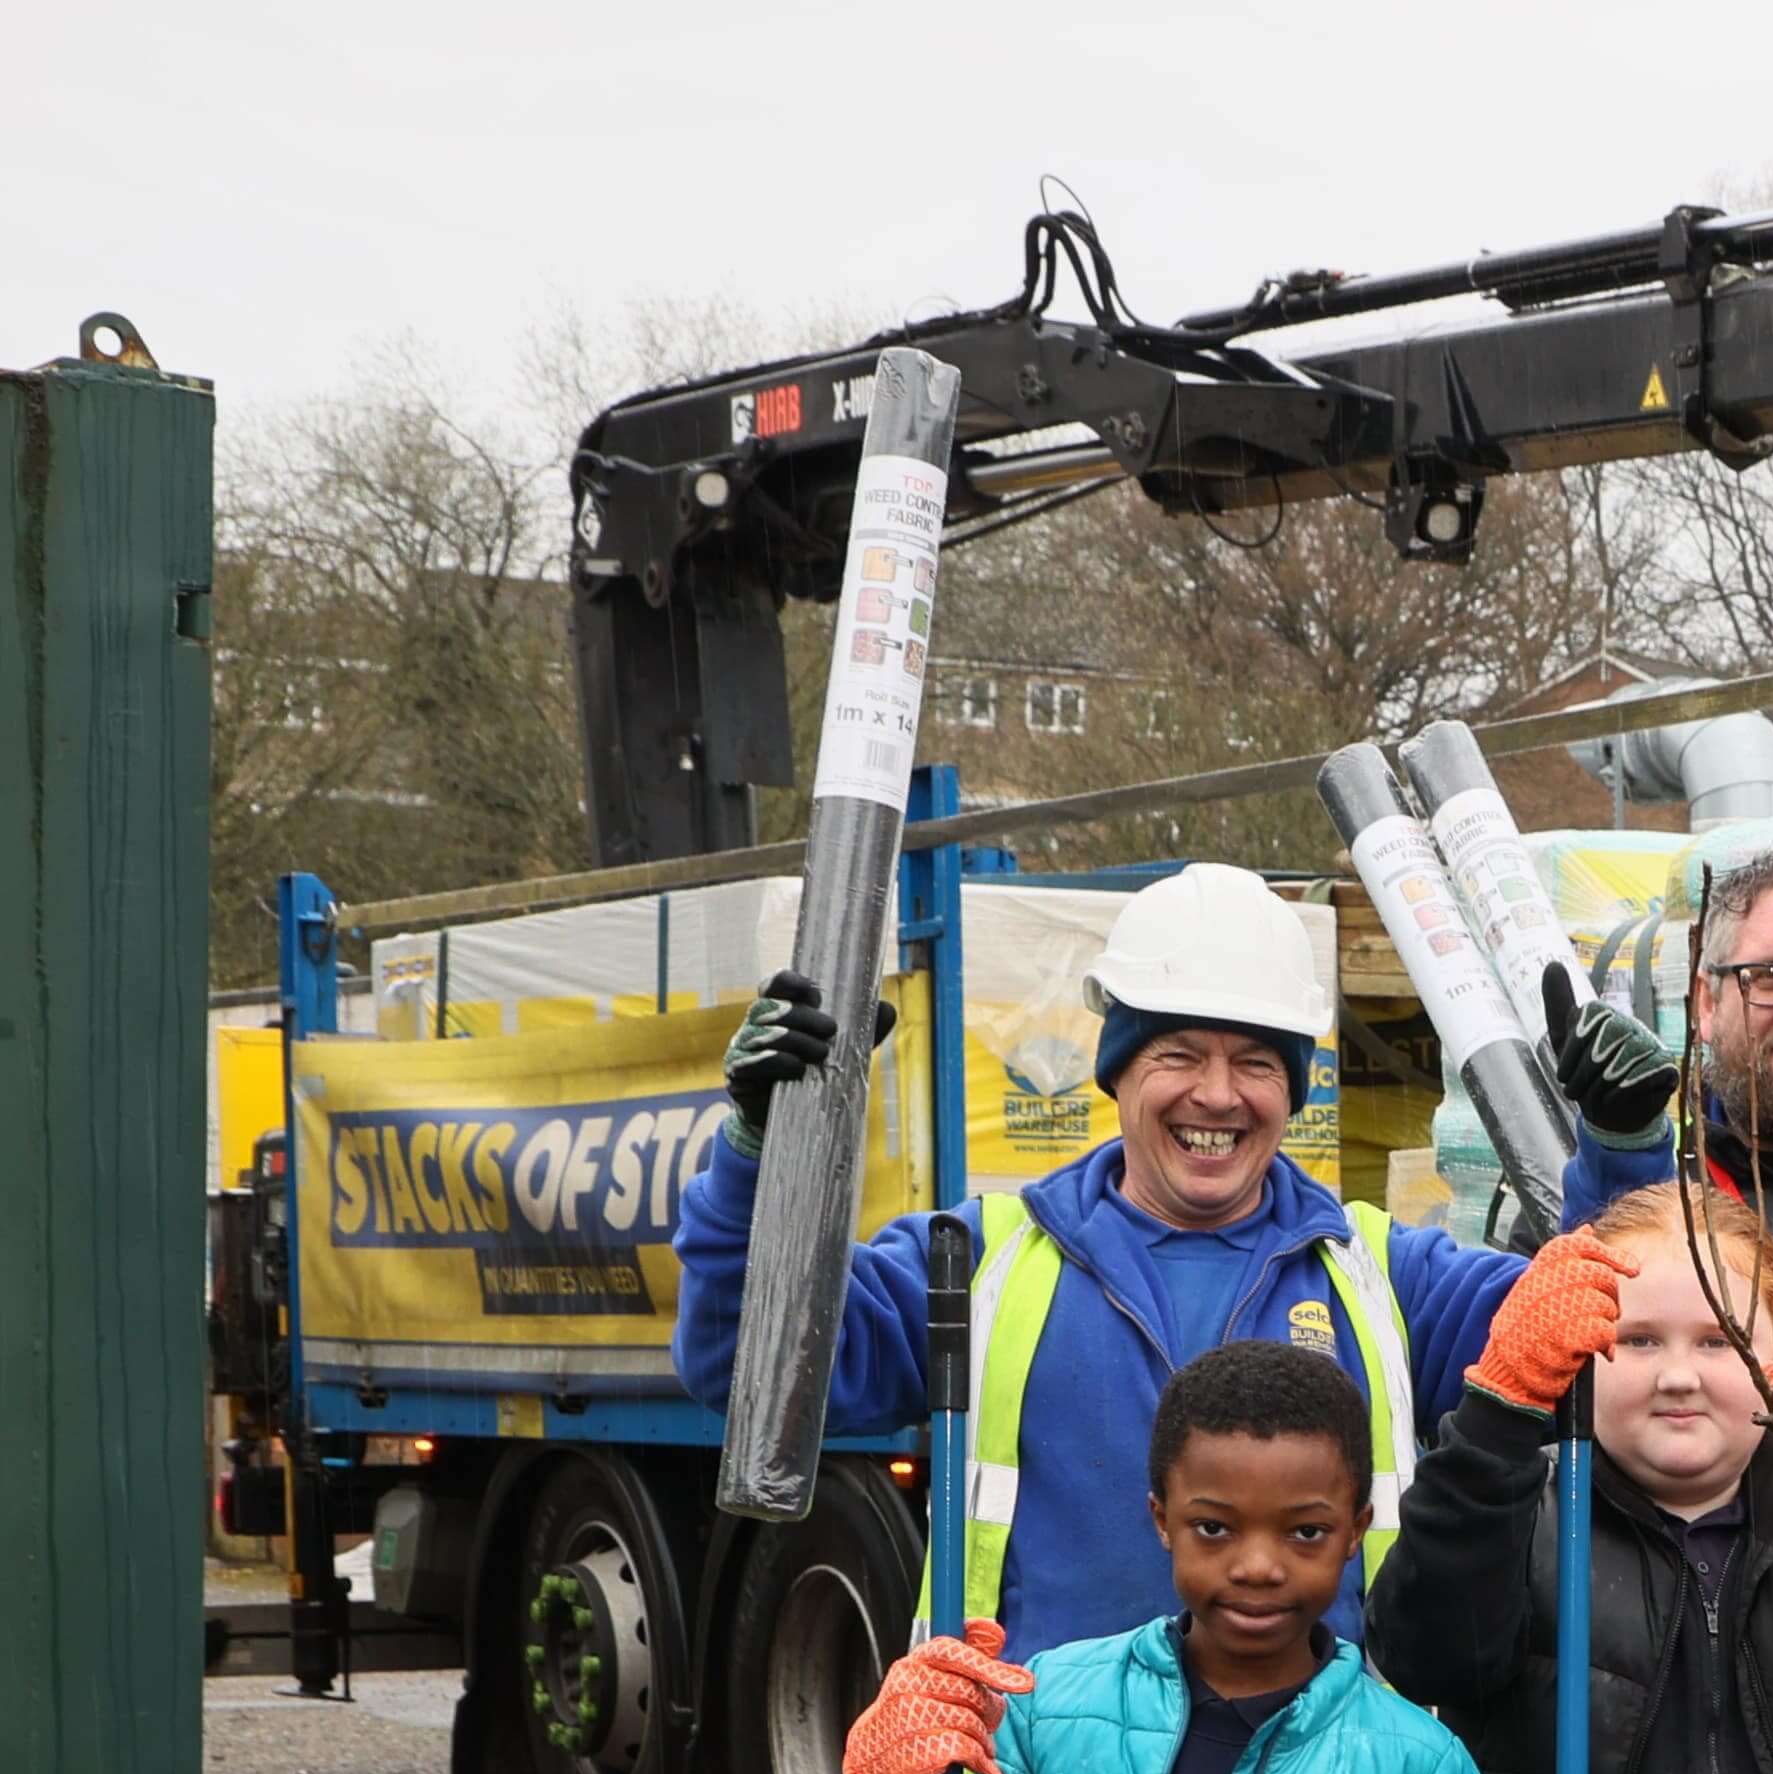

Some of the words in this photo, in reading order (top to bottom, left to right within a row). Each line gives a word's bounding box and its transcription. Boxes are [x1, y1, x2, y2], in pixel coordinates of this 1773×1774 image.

[755, 383, 801, 438] HIAB
[886, 508, 936, 535] FABRIC
[835, 703, 864, 722] 1m
[872, 710, 888, 727] x
[335, 1120, 517, 1235] STACKS
[513, 1117, 613, 1234] OF
[603, 1101, 733, 1231] STO
[1293, 1307, 1330, 1325] selc
